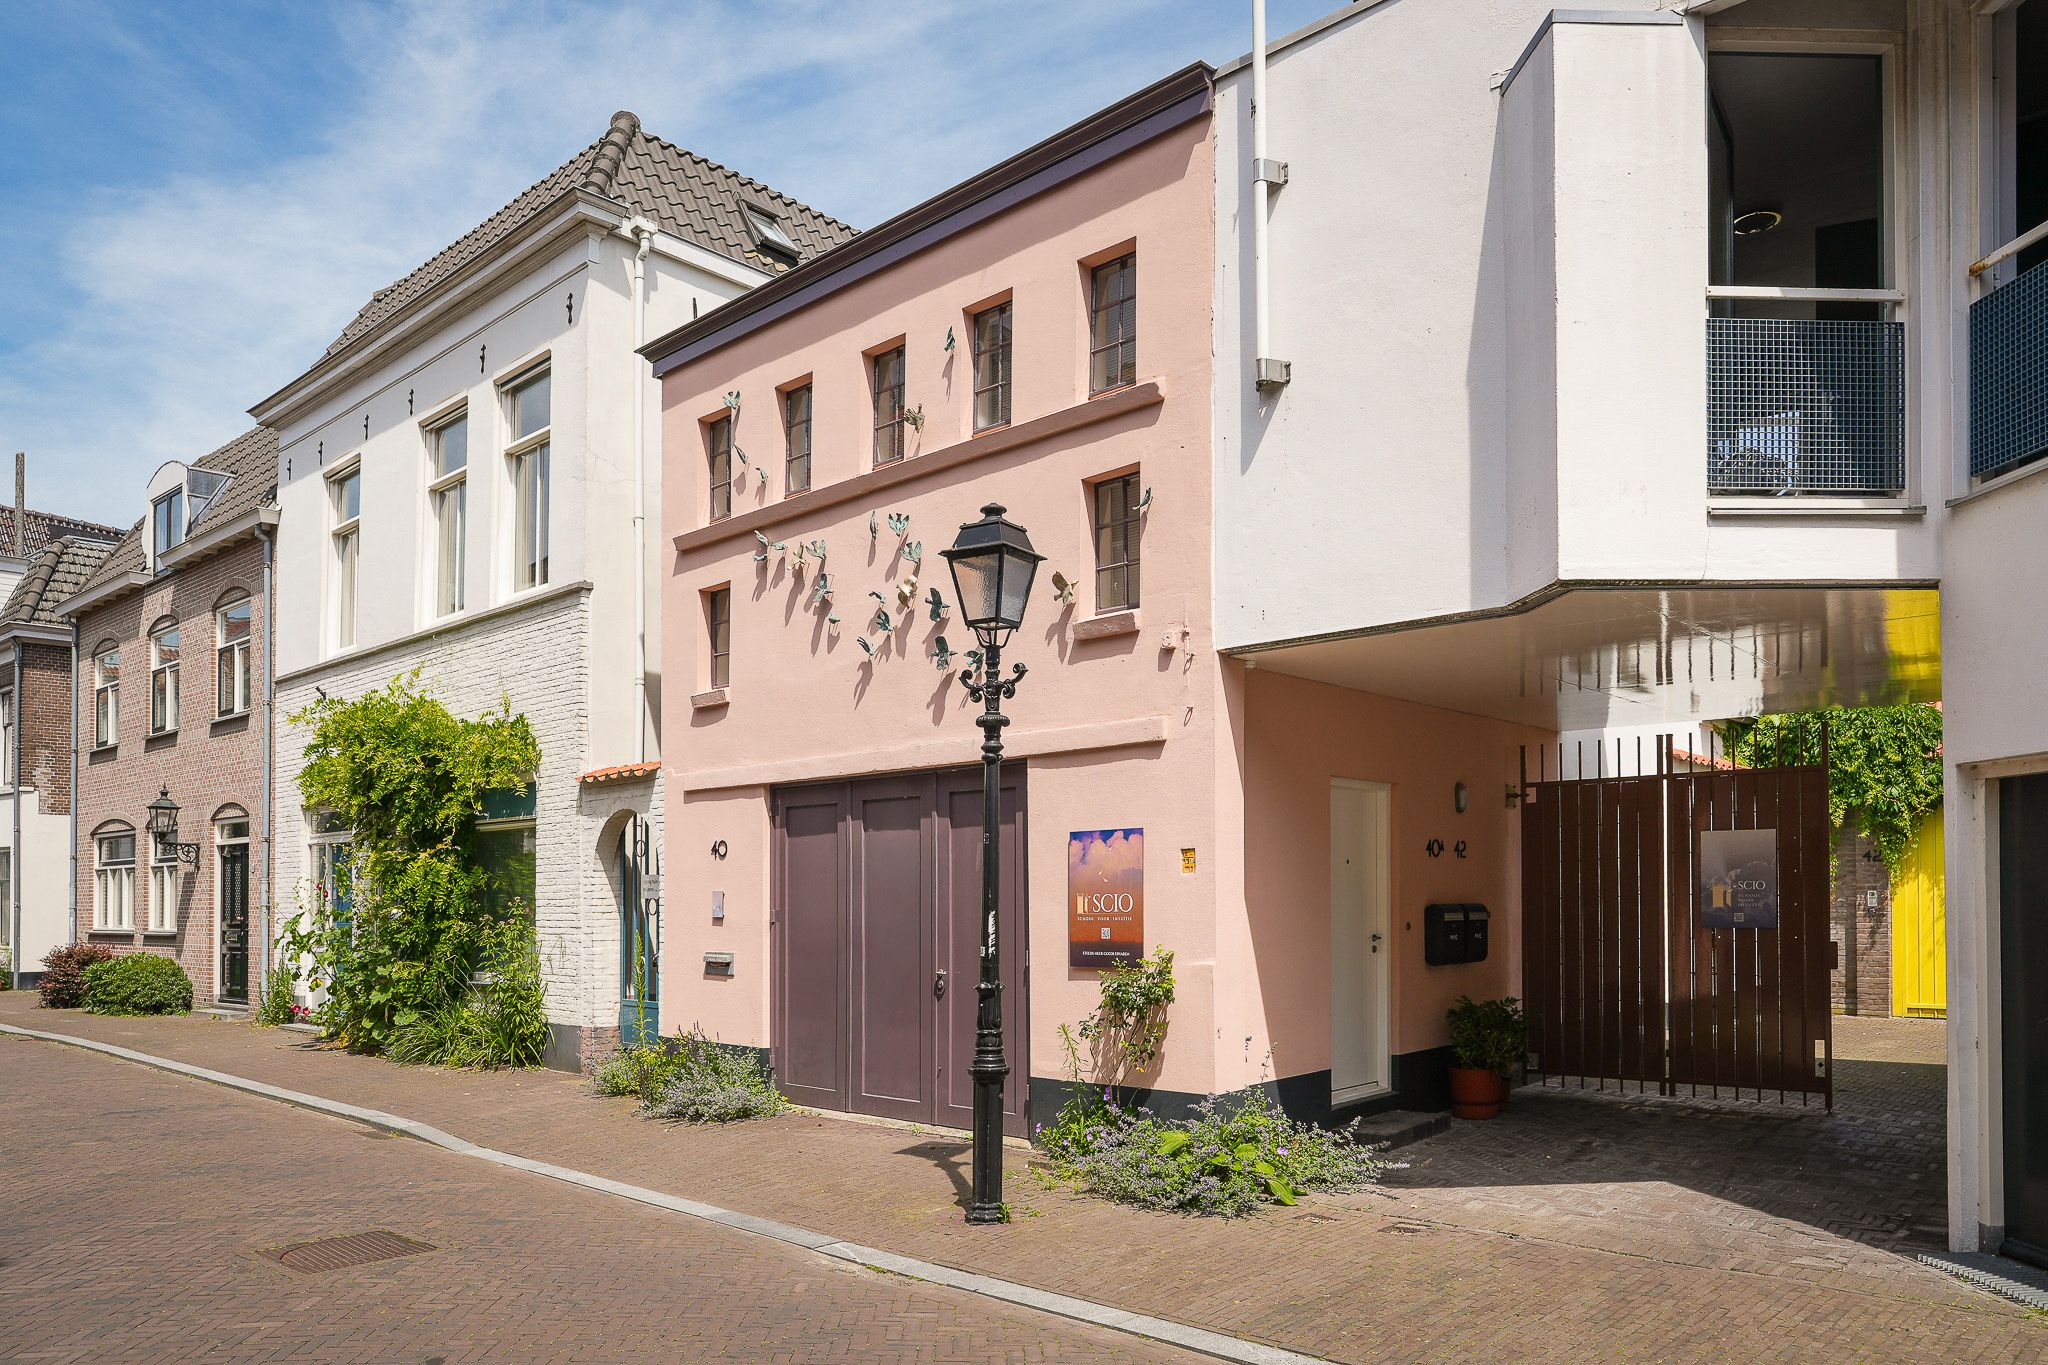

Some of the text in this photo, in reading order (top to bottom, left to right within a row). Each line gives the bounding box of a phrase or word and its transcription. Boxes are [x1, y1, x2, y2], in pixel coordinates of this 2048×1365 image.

[711, 840, 728, 860] 40
[1454, 839, 1467, 859] 42
[1863, 849, 1883, 862] 42
[1737, 880, 1766, 890] SCIO
[1092, 893, 1133, 912] SCIO
